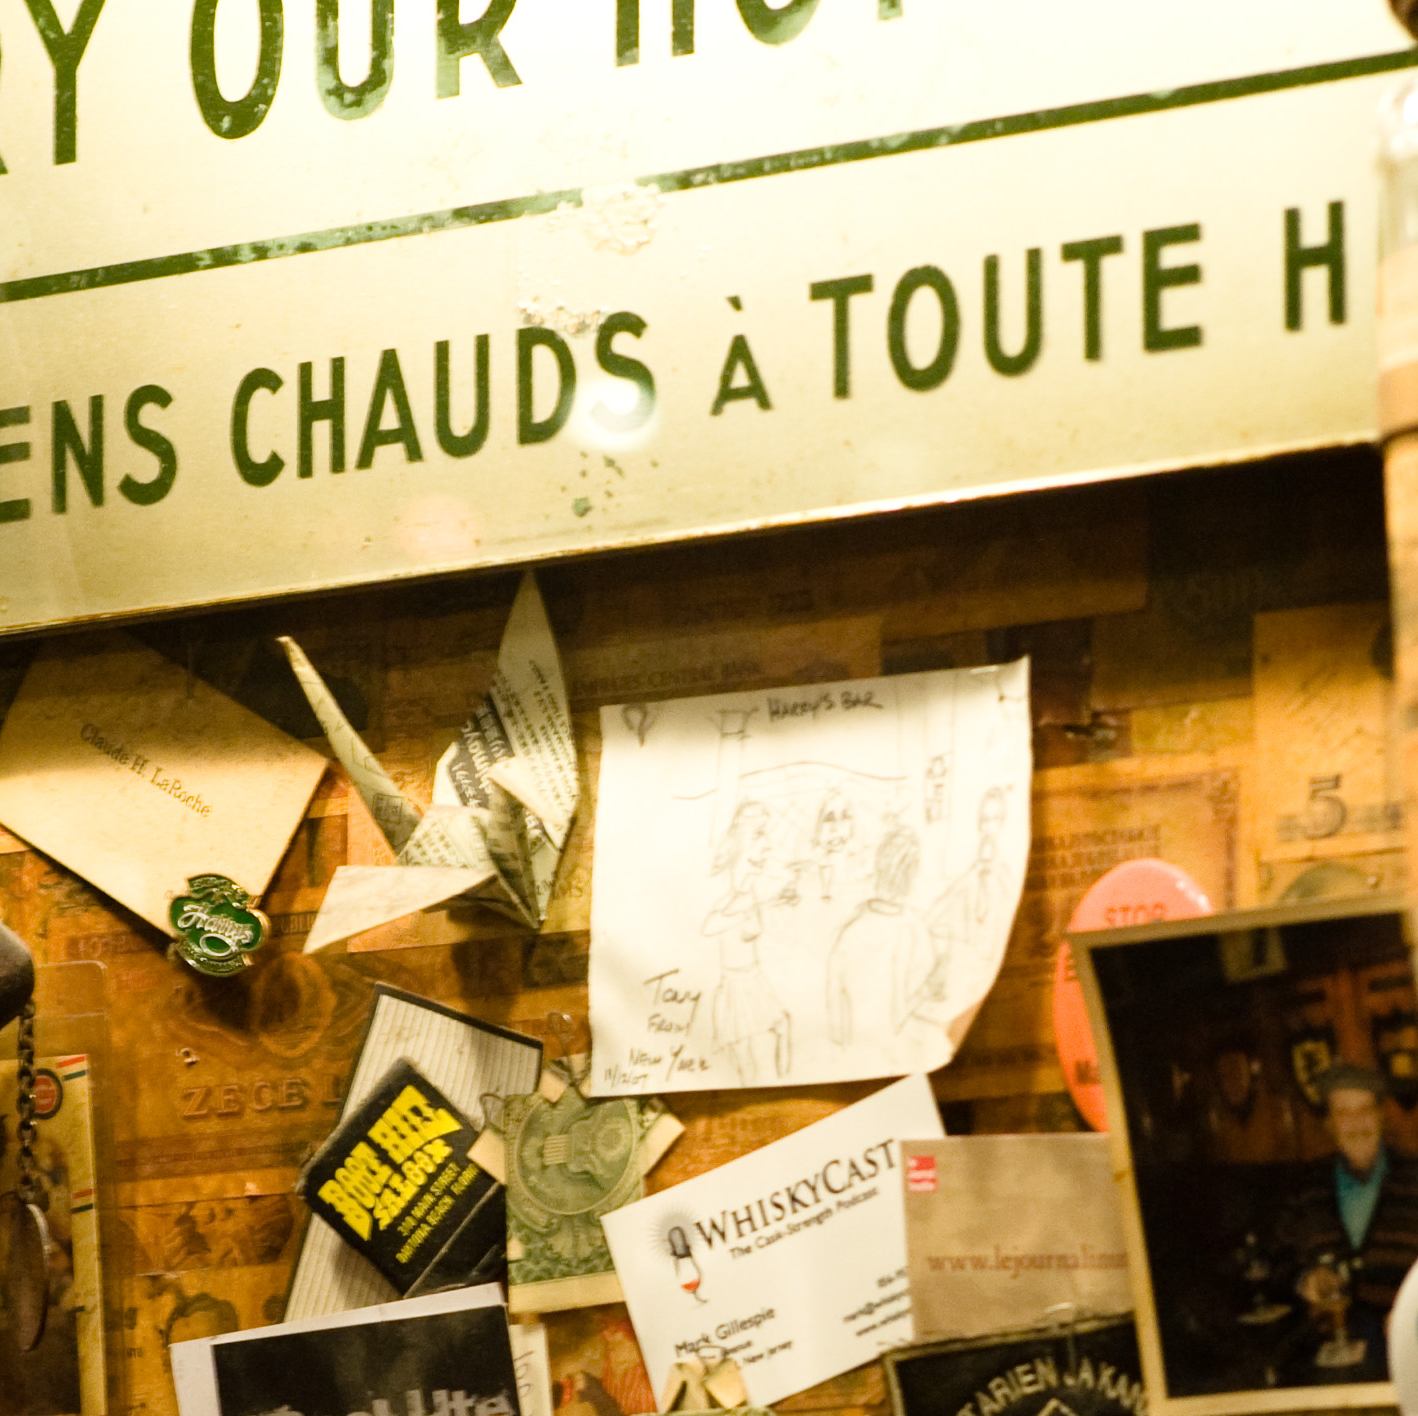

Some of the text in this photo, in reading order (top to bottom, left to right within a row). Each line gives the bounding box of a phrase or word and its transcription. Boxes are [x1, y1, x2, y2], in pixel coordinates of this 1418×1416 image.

[231, 311, 656, 487] CHAUDS
[712, 295, 773, 416] À
[810, 223, 1204, 400] TOUTE
[80, 722, 129, 766] Claude
[317, 1140, 395, 1242] BOOT
[372, 1137, 454, 1232] SALOON
[696, 1138, 898, 1251] WHISKYCAST
